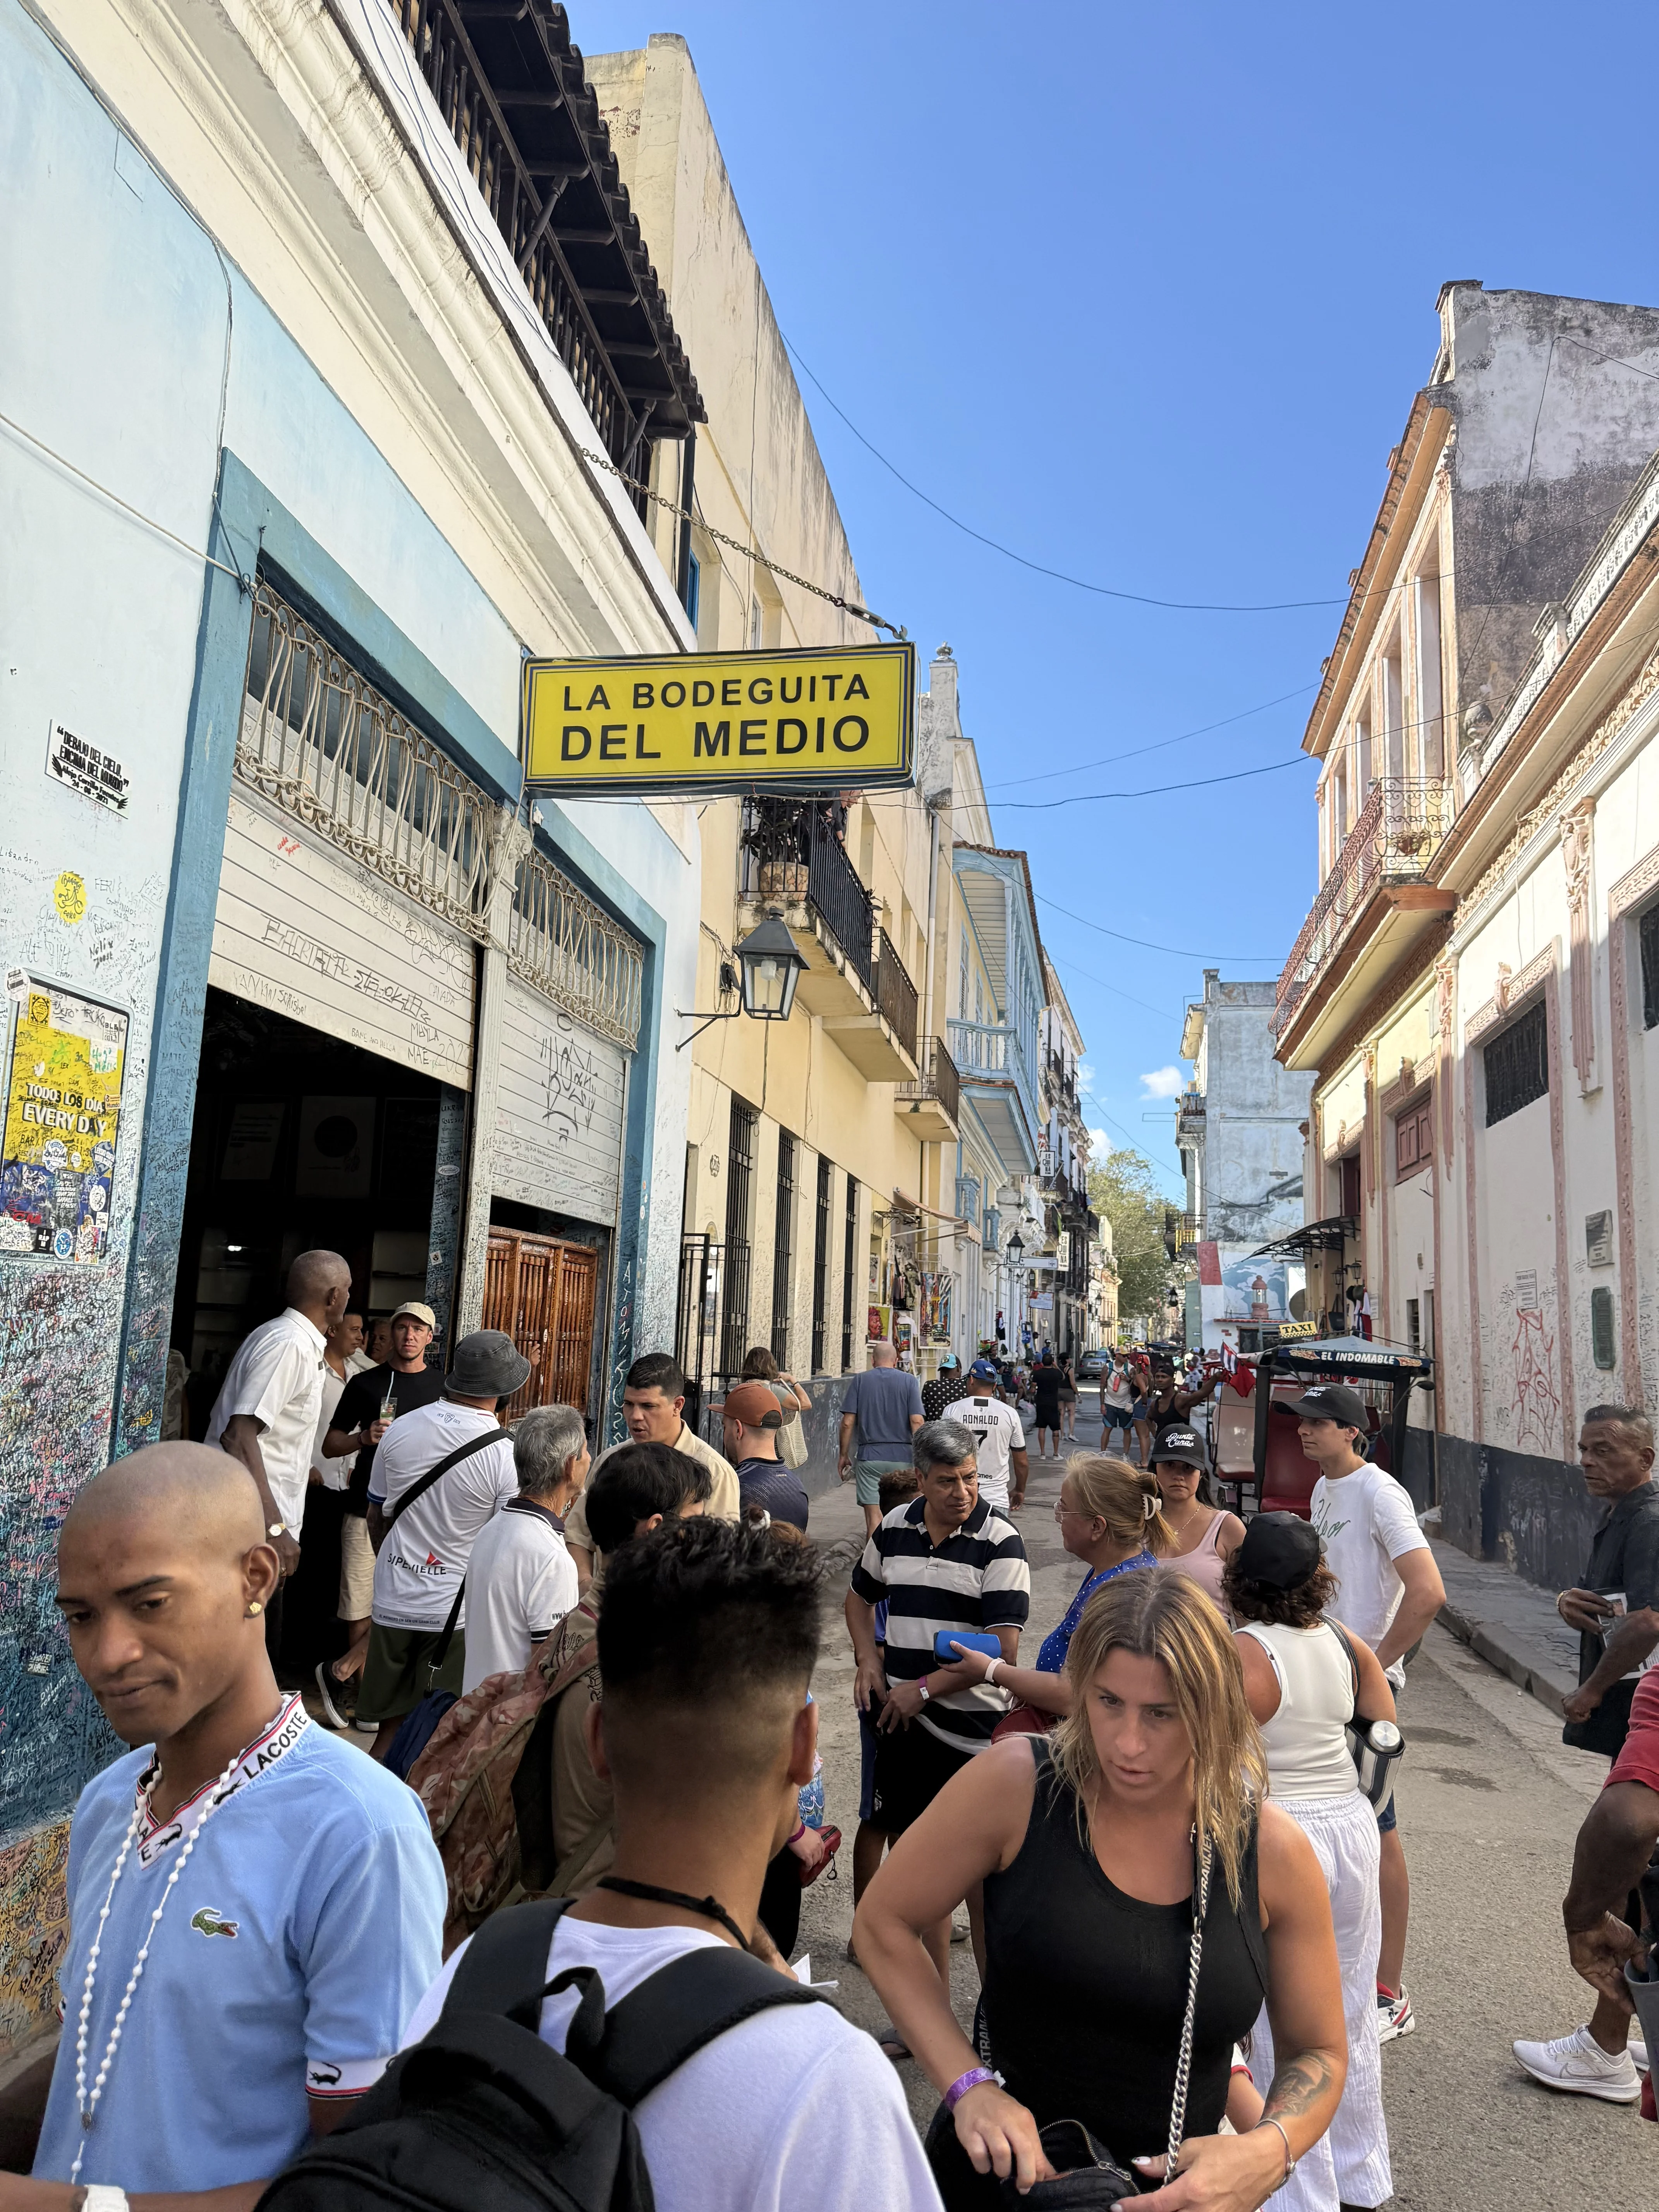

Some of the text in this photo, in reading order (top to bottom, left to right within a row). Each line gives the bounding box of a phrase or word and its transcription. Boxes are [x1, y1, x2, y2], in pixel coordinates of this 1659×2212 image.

[563, 673, 870, 711] LA BODEGUITA
[561, 715, 869, 761] DEL MEDIO
[60, 744, 86, 771] ENCIMA
[87, 761, 99, 779] DEL
[89, 747, 102, 766] DEL
[26, 1082, 62, 1103] TODOS
[64, 1092, 83, 1109] LOS
[22, 1102, 76, 1132] EVERY
[1282, 1324, 1312, 1334] TAXI
[1321, 1352, 1394, 1365] EL INDOMABLE
[963, 1414, 998, 1425] RONALDO
[972, 1430, 988, 1448] 7
[1165, 1432, 1196, 1442] Punta
[242, 1711, 307, 1780] LACOSTE
